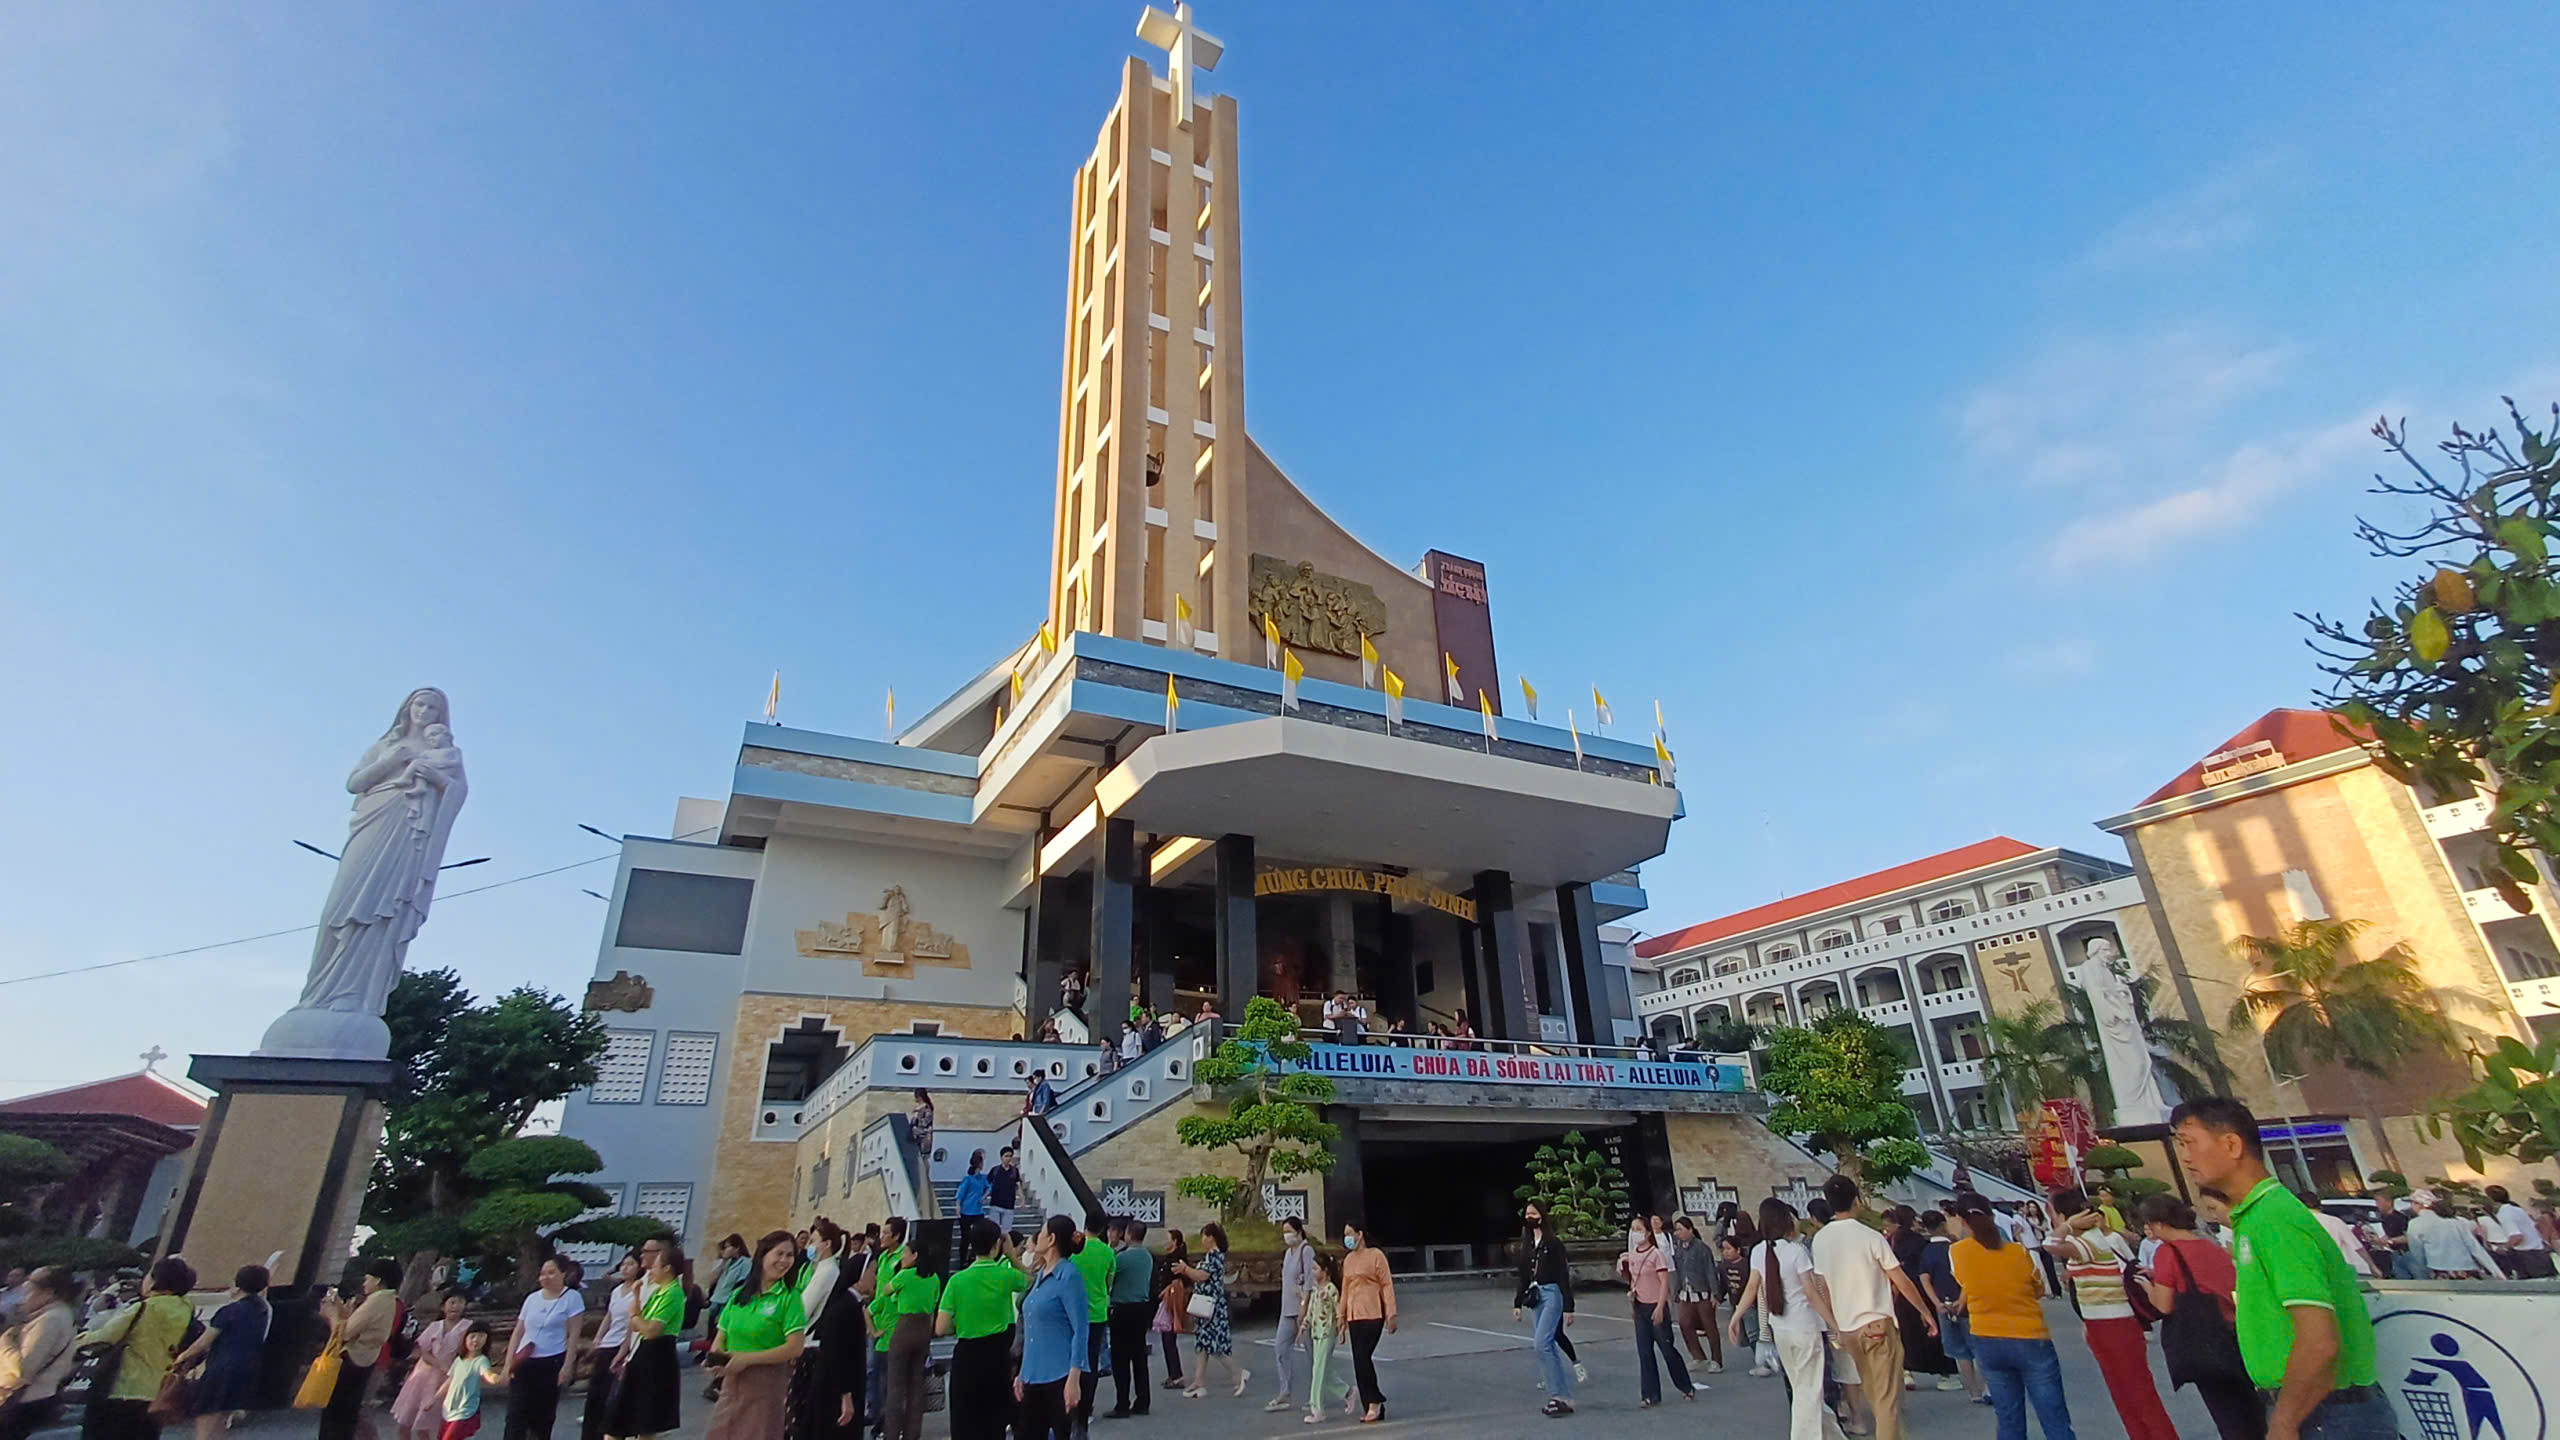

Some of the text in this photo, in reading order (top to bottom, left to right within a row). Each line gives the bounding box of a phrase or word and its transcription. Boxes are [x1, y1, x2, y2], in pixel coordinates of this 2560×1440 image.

[1311, 864, 1369, 891] CHÚA
[1428, 886, 1478, 922] SINH
[1413, 1053, 1460, 1076] CHÚA
[1466, 1055, 1491, 1077] ĐÃ
[1496, 1055, 1540, 1079] SỐNG
[1544, 1062, 1572, 1084] LẠI
[1575, 1061, 1615, 1086] THẬT
[1629, 1066, 1701, 1087] ALLELUIA
